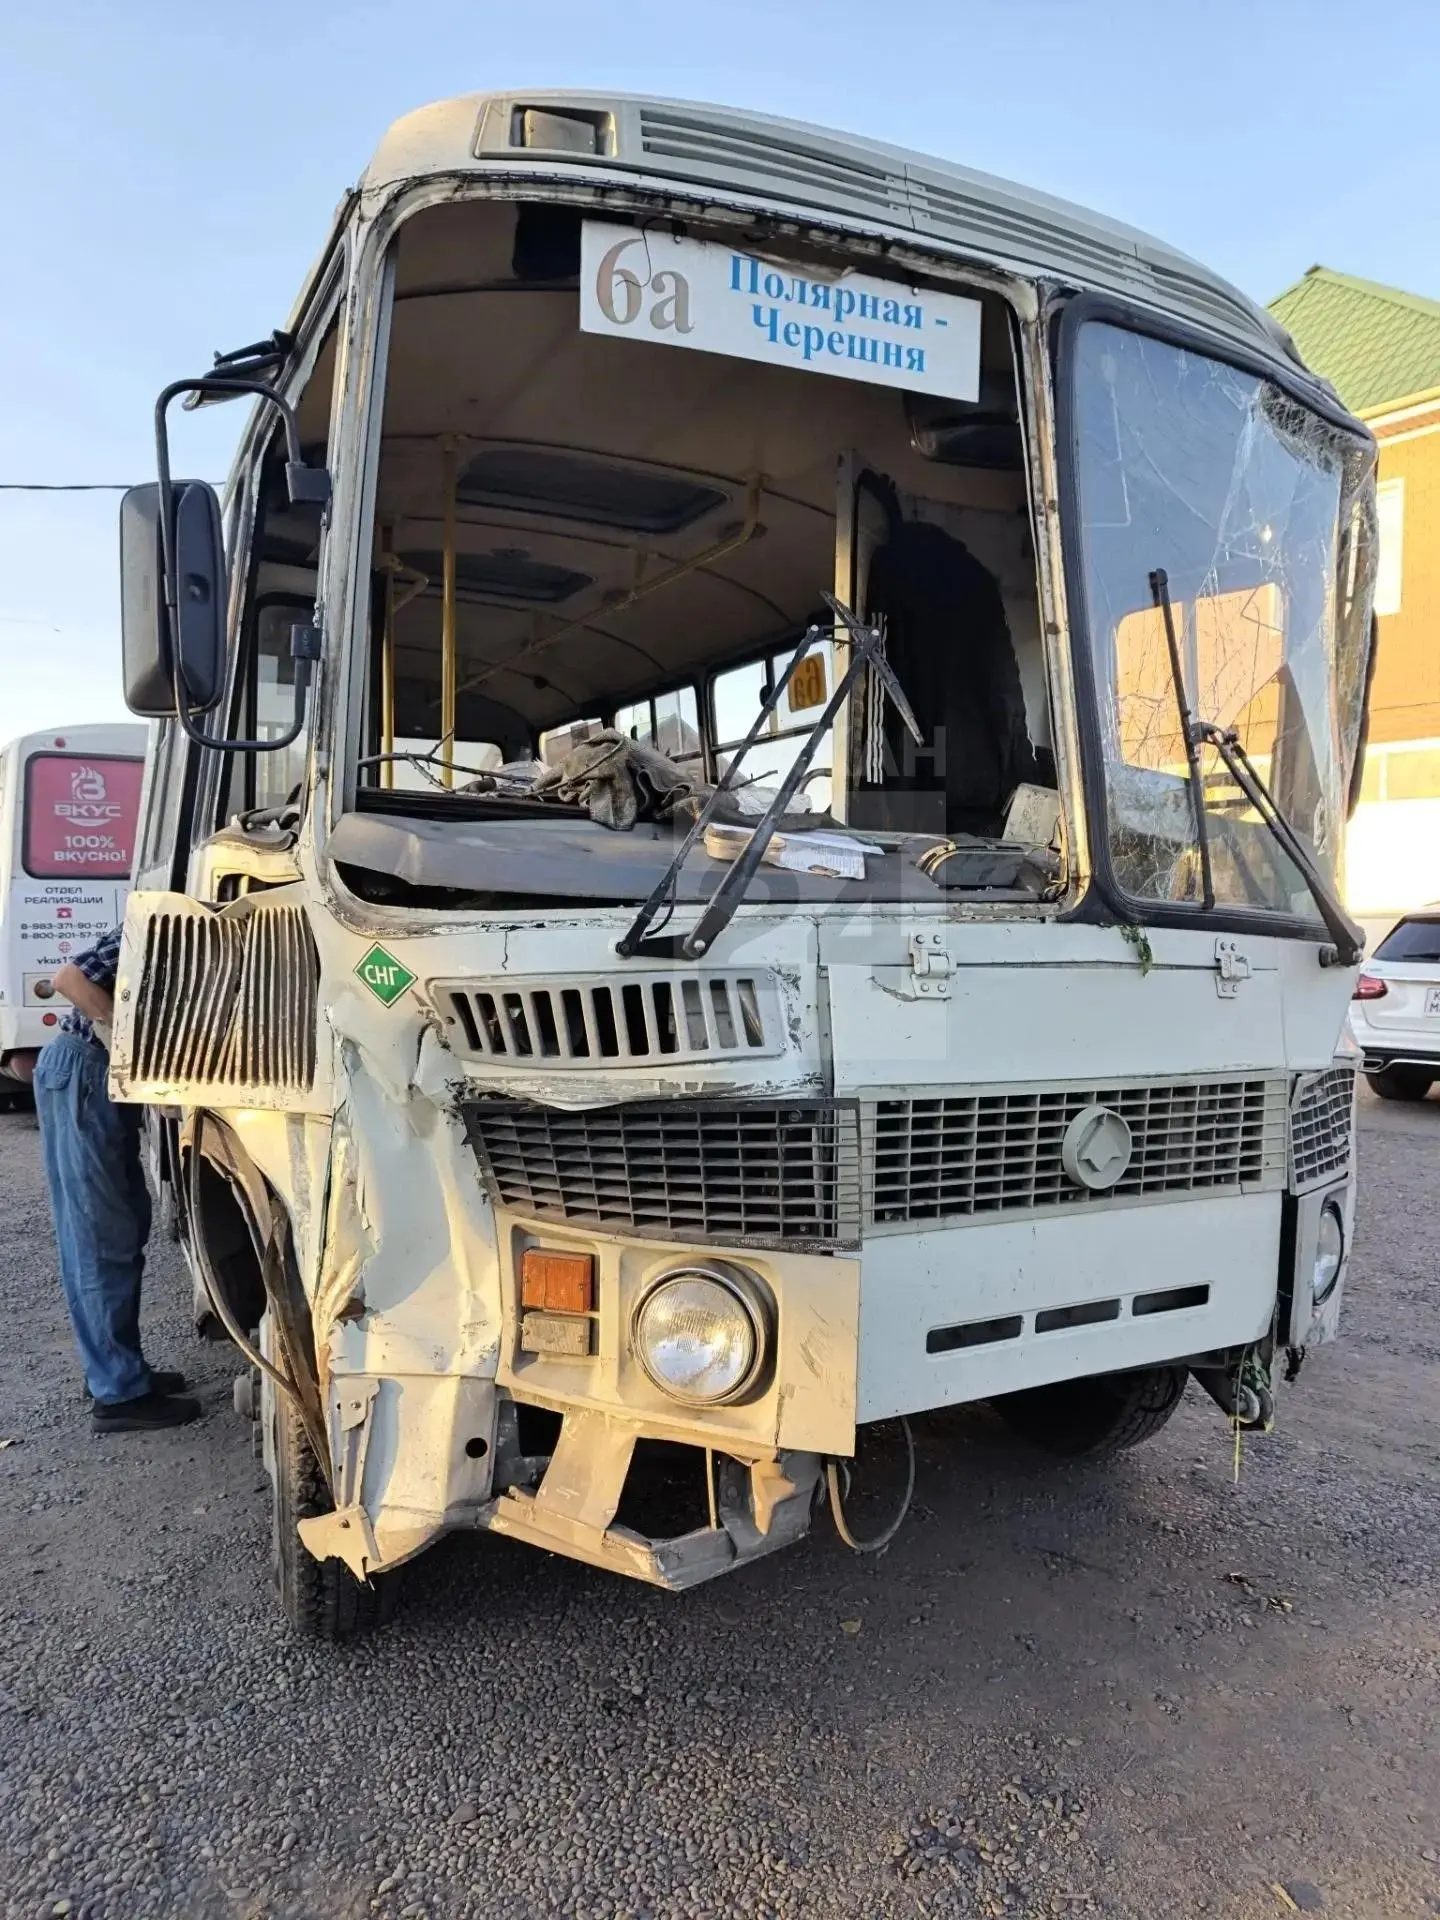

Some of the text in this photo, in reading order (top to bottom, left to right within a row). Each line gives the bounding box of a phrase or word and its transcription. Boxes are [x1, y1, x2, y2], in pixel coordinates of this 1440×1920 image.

[595, 238, 696, 335] 6а
[729, 254, 924, 330] Полярная
[750, 303, 926, 373] Черешня
[54, 803, 122, 818] ВКУС
[64, 835, 115, 850] 100%
[45, 886, 83, 895] ОТДЕЛ
[24, 896, 104, 905] РЕАЛИЗАЦИИ
[364, 964, 400, 986] СНГ
